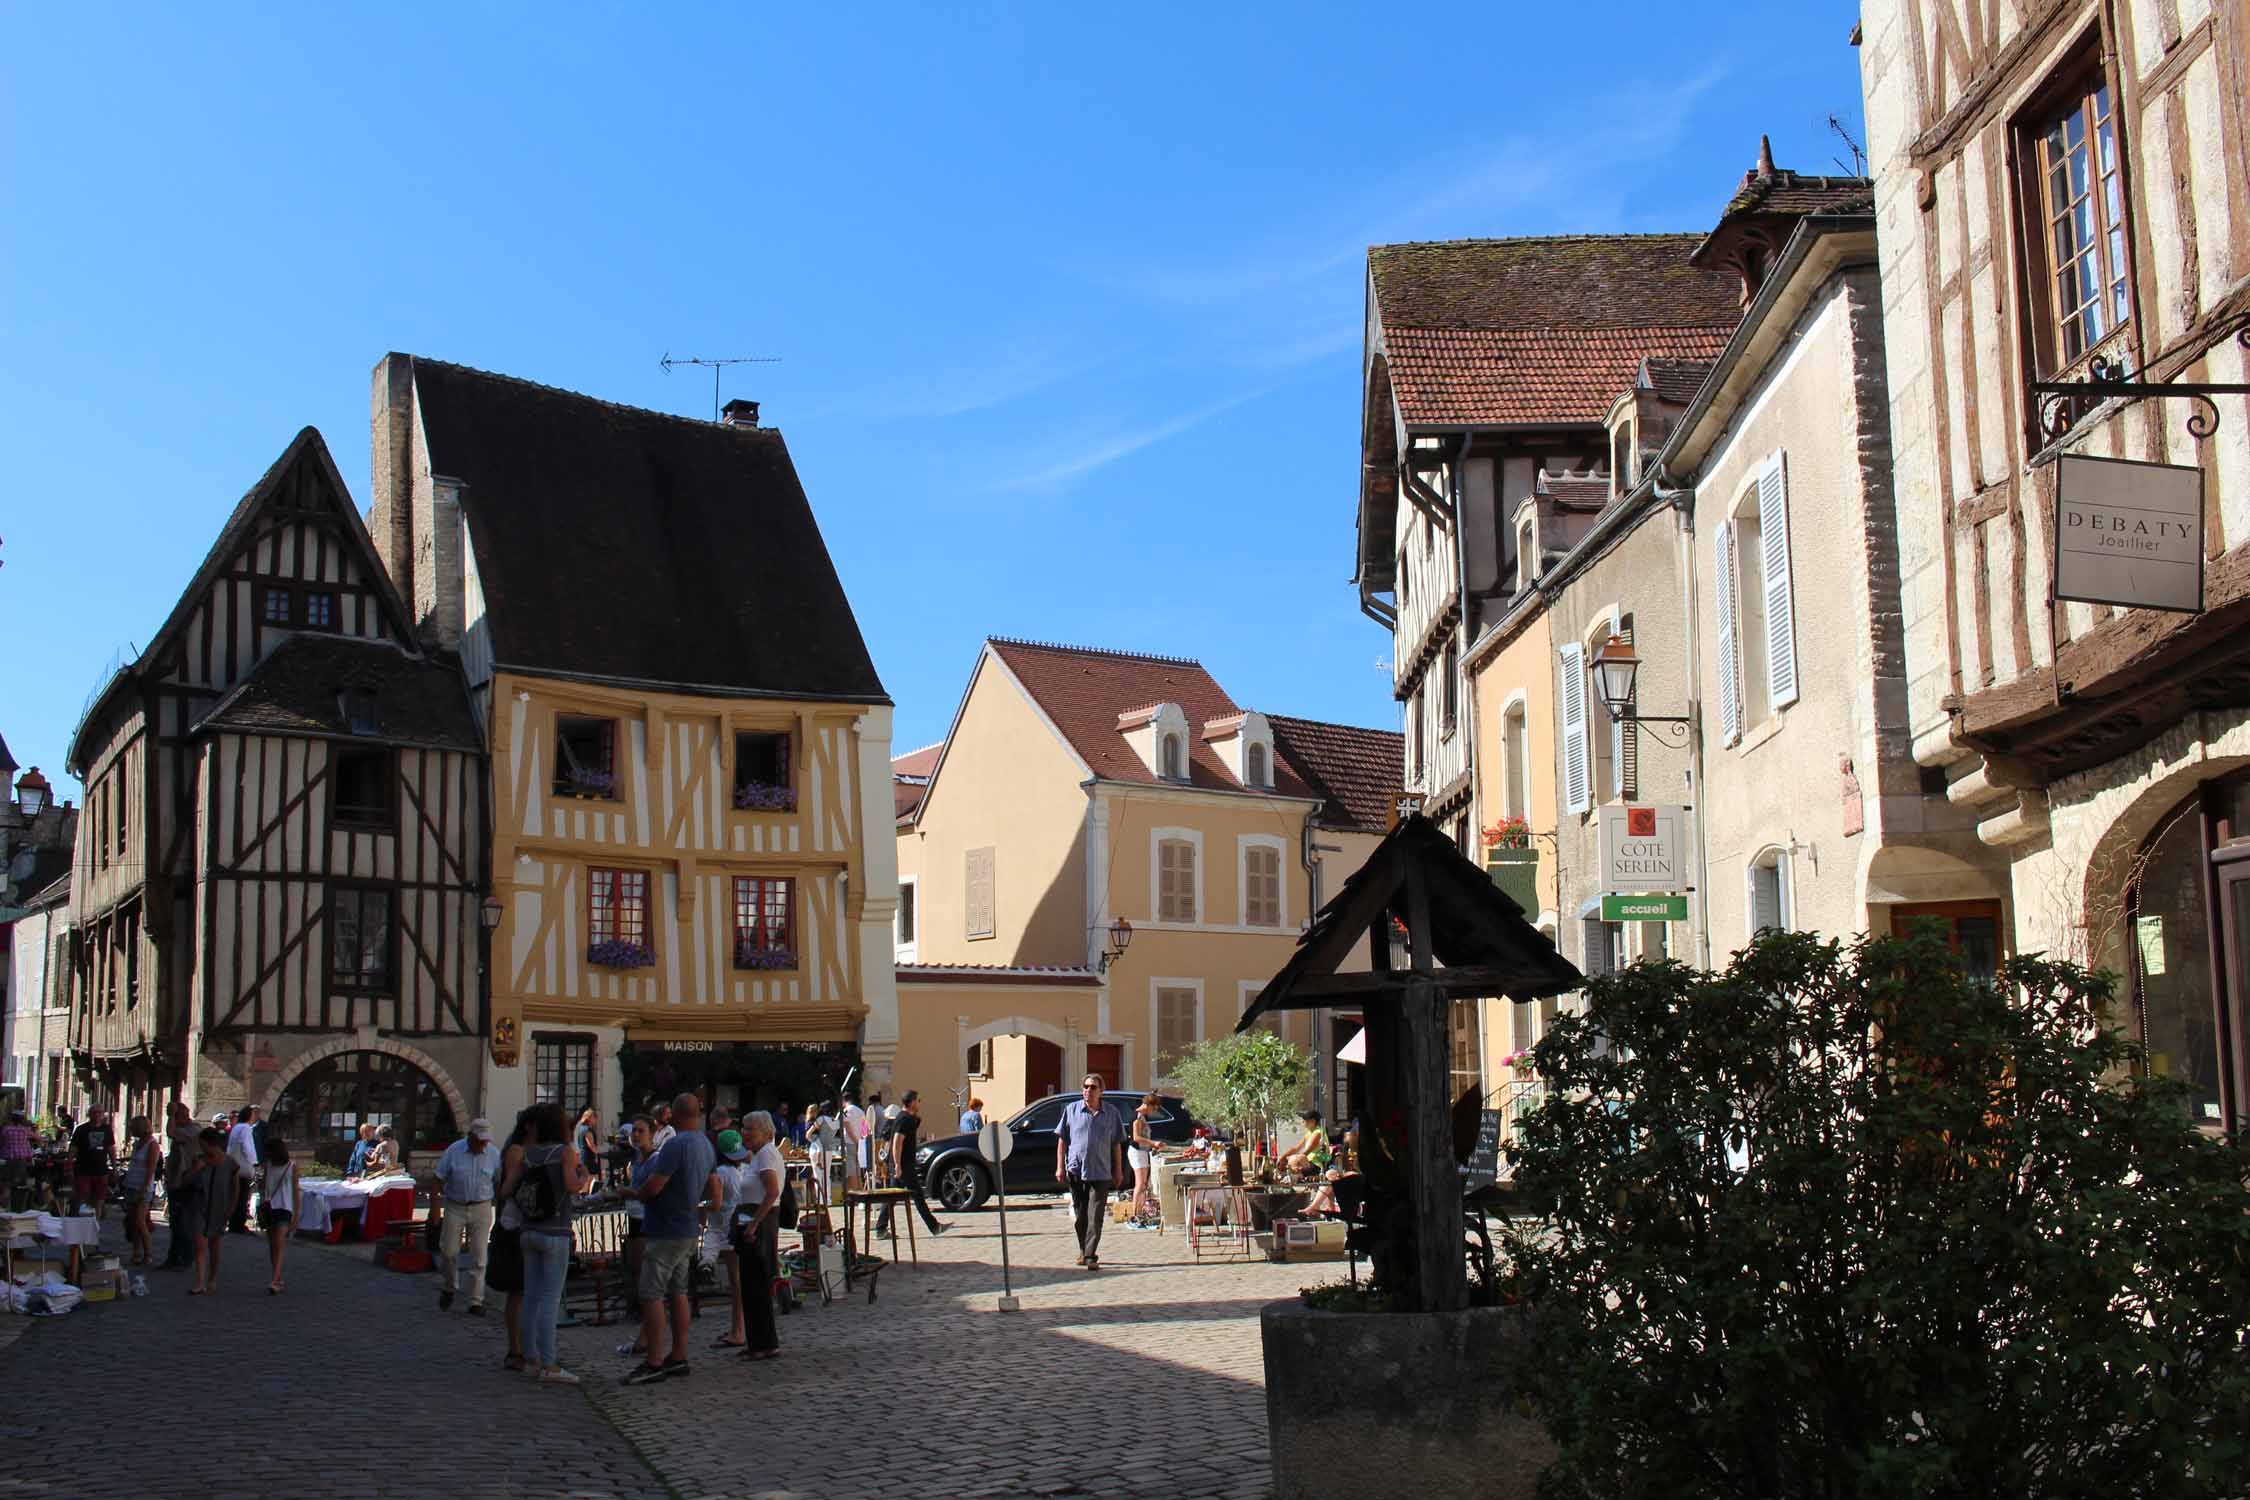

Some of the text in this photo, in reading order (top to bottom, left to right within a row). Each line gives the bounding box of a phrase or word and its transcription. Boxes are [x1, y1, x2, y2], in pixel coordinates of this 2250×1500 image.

[2068, 512, 2192, 538] DEBATY
[2098, 534, 2161, 552] Joaillier
[1621, 839, 1665, 857] CÔTÉ
[1615, 860, 1671, 873] SEREIN
[1621, 903, 1668, 914] accueil
[664, 1041, 713, 1052] MAISON
